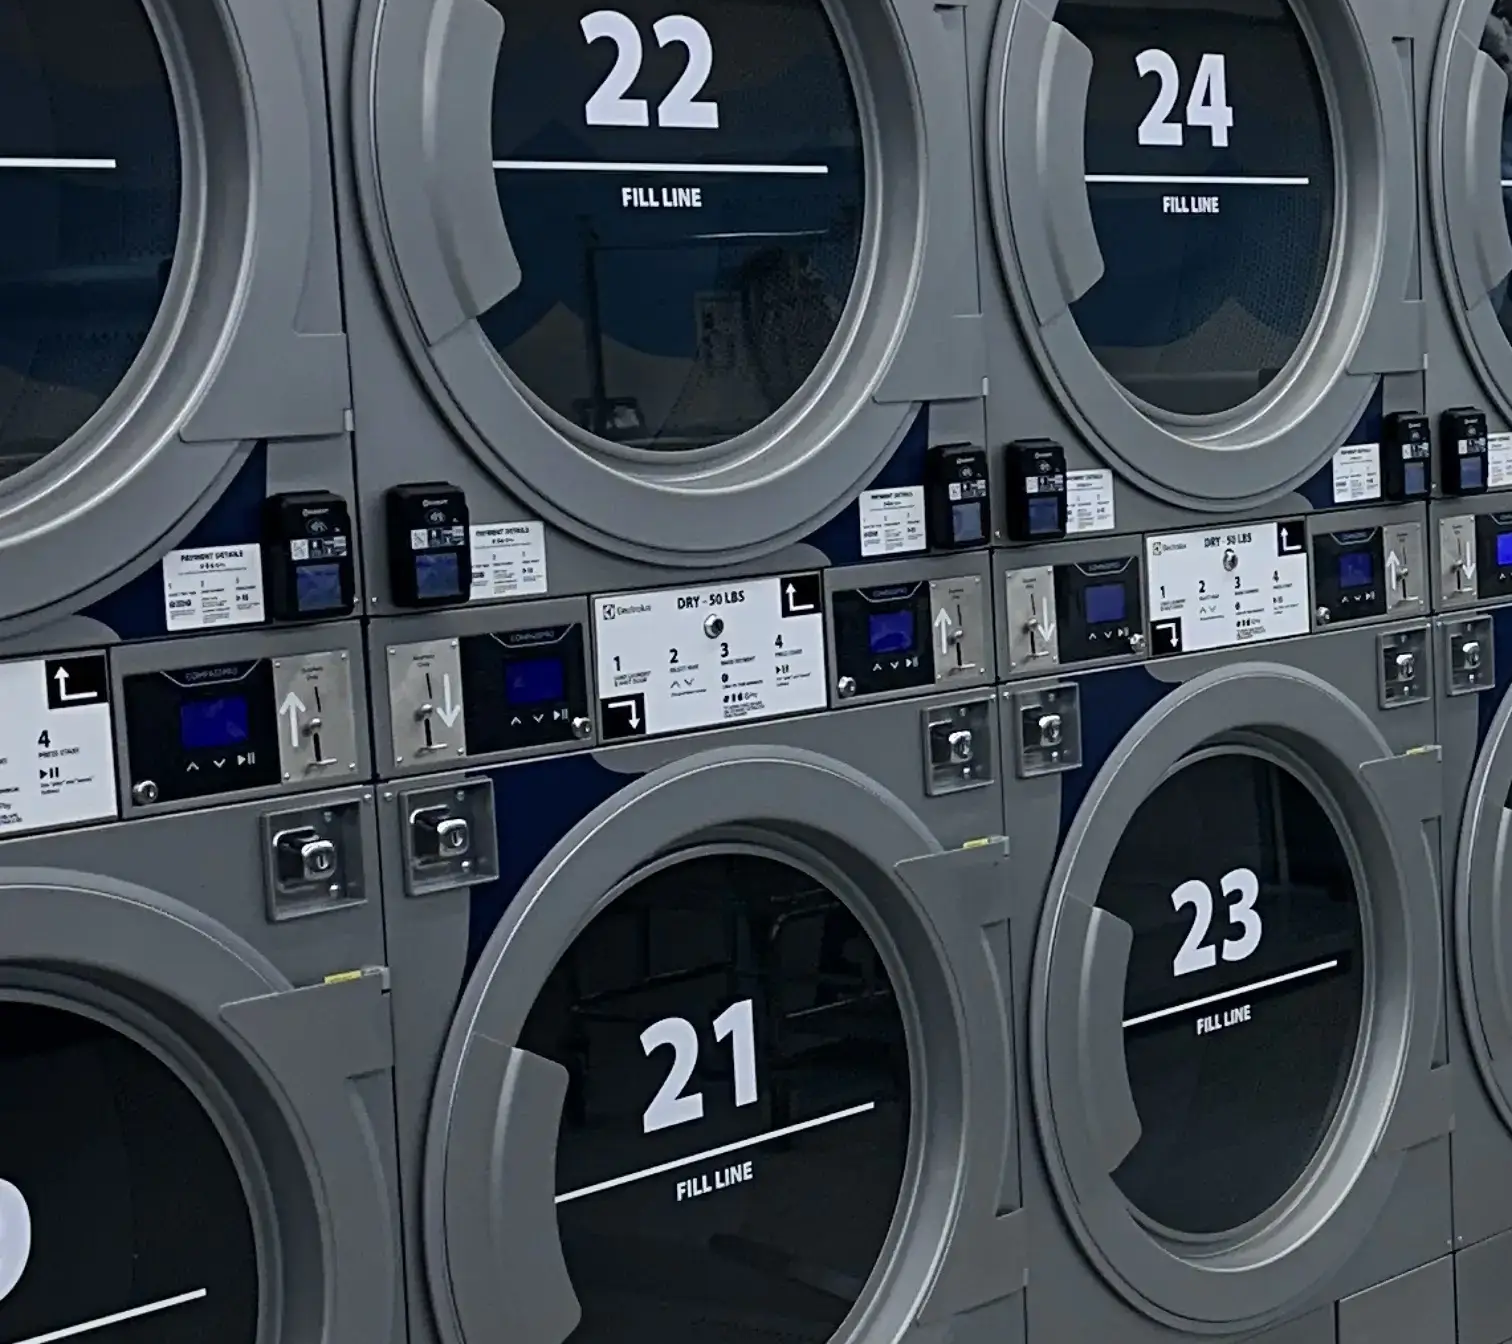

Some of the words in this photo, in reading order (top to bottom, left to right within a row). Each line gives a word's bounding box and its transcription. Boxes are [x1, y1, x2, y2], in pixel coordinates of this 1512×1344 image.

[580, 10, 719, 128] 22
[1135, 48, 1233, 147] 24
[622, 188, 659, 207] FILL
[662, 188, 702, 207] LINE
[1163, 196, 1189, 213] FILL
[1191, 197, 1219, 213] LINE
[1204, 537, 1221, 548] DRY
[1238, 532, 1252, 544] LBS
[1199, 580, 1206, 593] 2
[1235, 576, 1241, 589] 3
[677, 597, 700, 610] DRY
[709, 594, 722, 606] 50
[725, 590, 745, 604] LBS
[1160, 585, 1166, 599] 1
[721, 642, 729, 658] 3
[775, 634, 784, 649] 4
[613, 656, 621, 671] 1
[669, 648, 679, 664] 2
[38, 730, 51, 748] 4
[1171, 868, 1262, 977] 23
[1196, 1014, 1222, 1035] FILL
[1224, 1004, 1251, 1027] LINE
[640, 999, 757, 1133] 21
[676, 1174, 712, 1201] FILL
[715, 1161, 753, 1189] LINE
